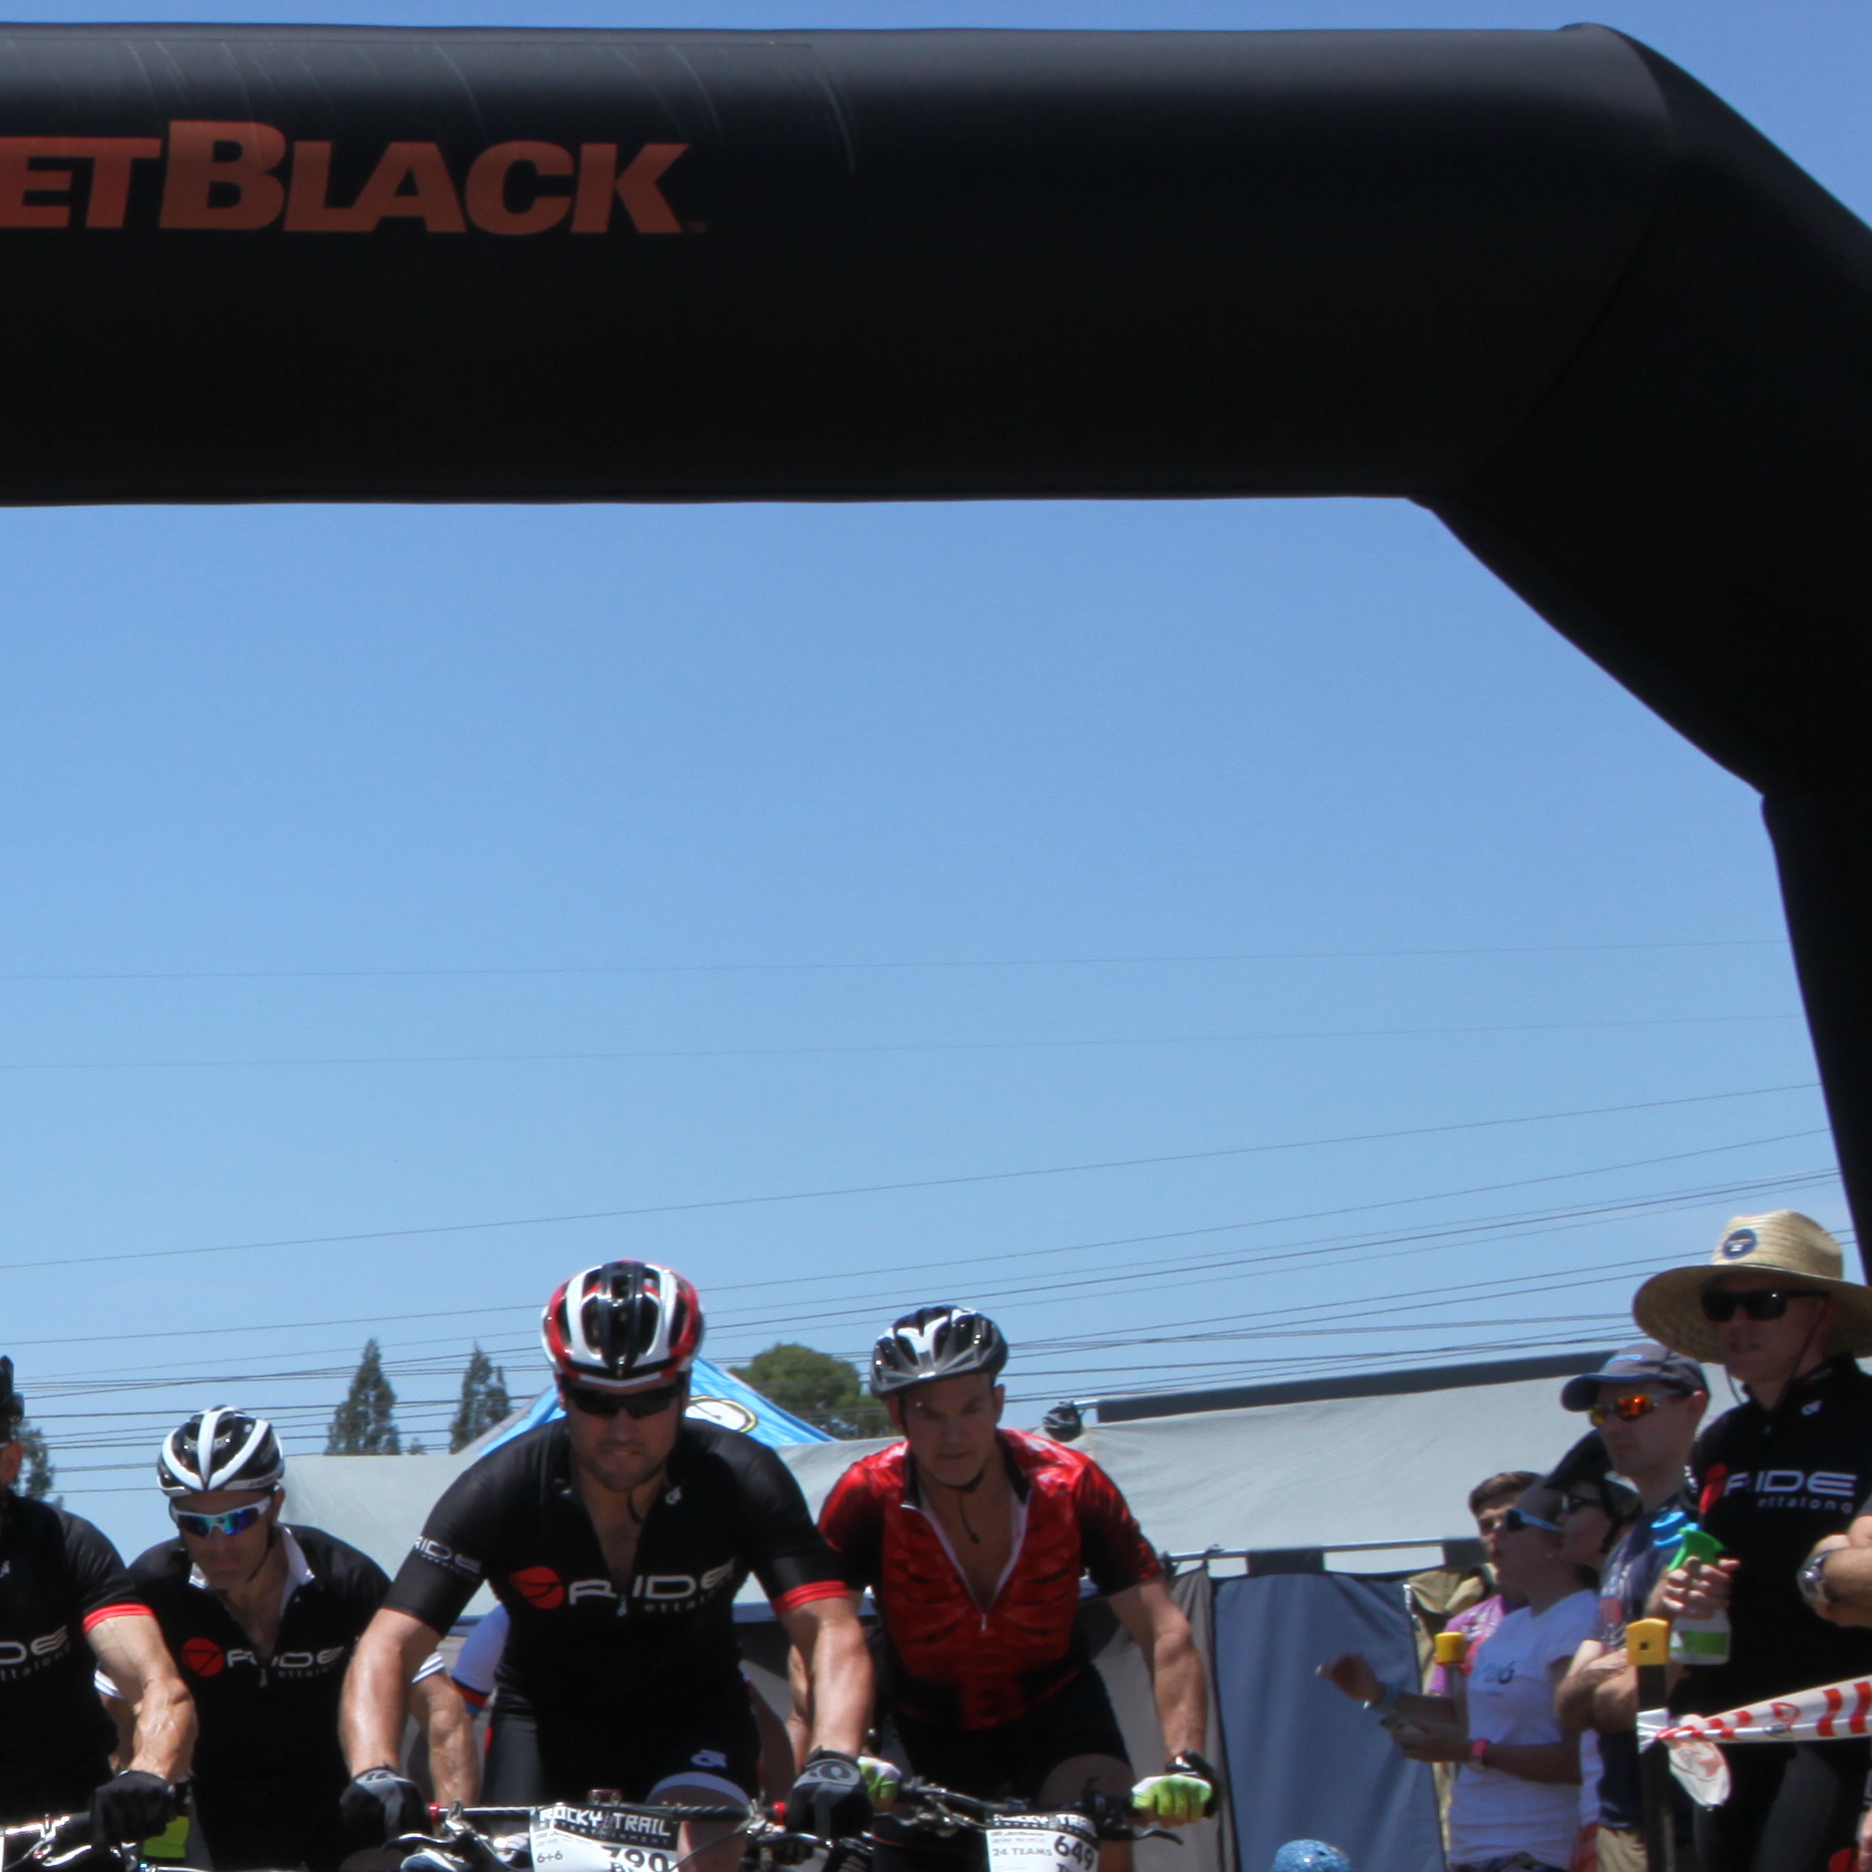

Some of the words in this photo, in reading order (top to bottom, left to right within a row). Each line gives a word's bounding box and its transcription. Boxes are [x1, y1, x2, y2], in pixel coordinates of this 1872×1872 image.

[567, 1556, 737, 1605] RIDE
[226, 1646, 345, 1668] RIDE
[539, 1806, 603, 1827] ROCKY
[612, 1812, 672, 1837] TRAIL
[536, 1850, 563, 1864] 6+6
[992, 1848, 1008, 1857] 24
[1012, 1847, 1053, 1857] TEAMS
[1053, 1834, 1095, 1872] 649
